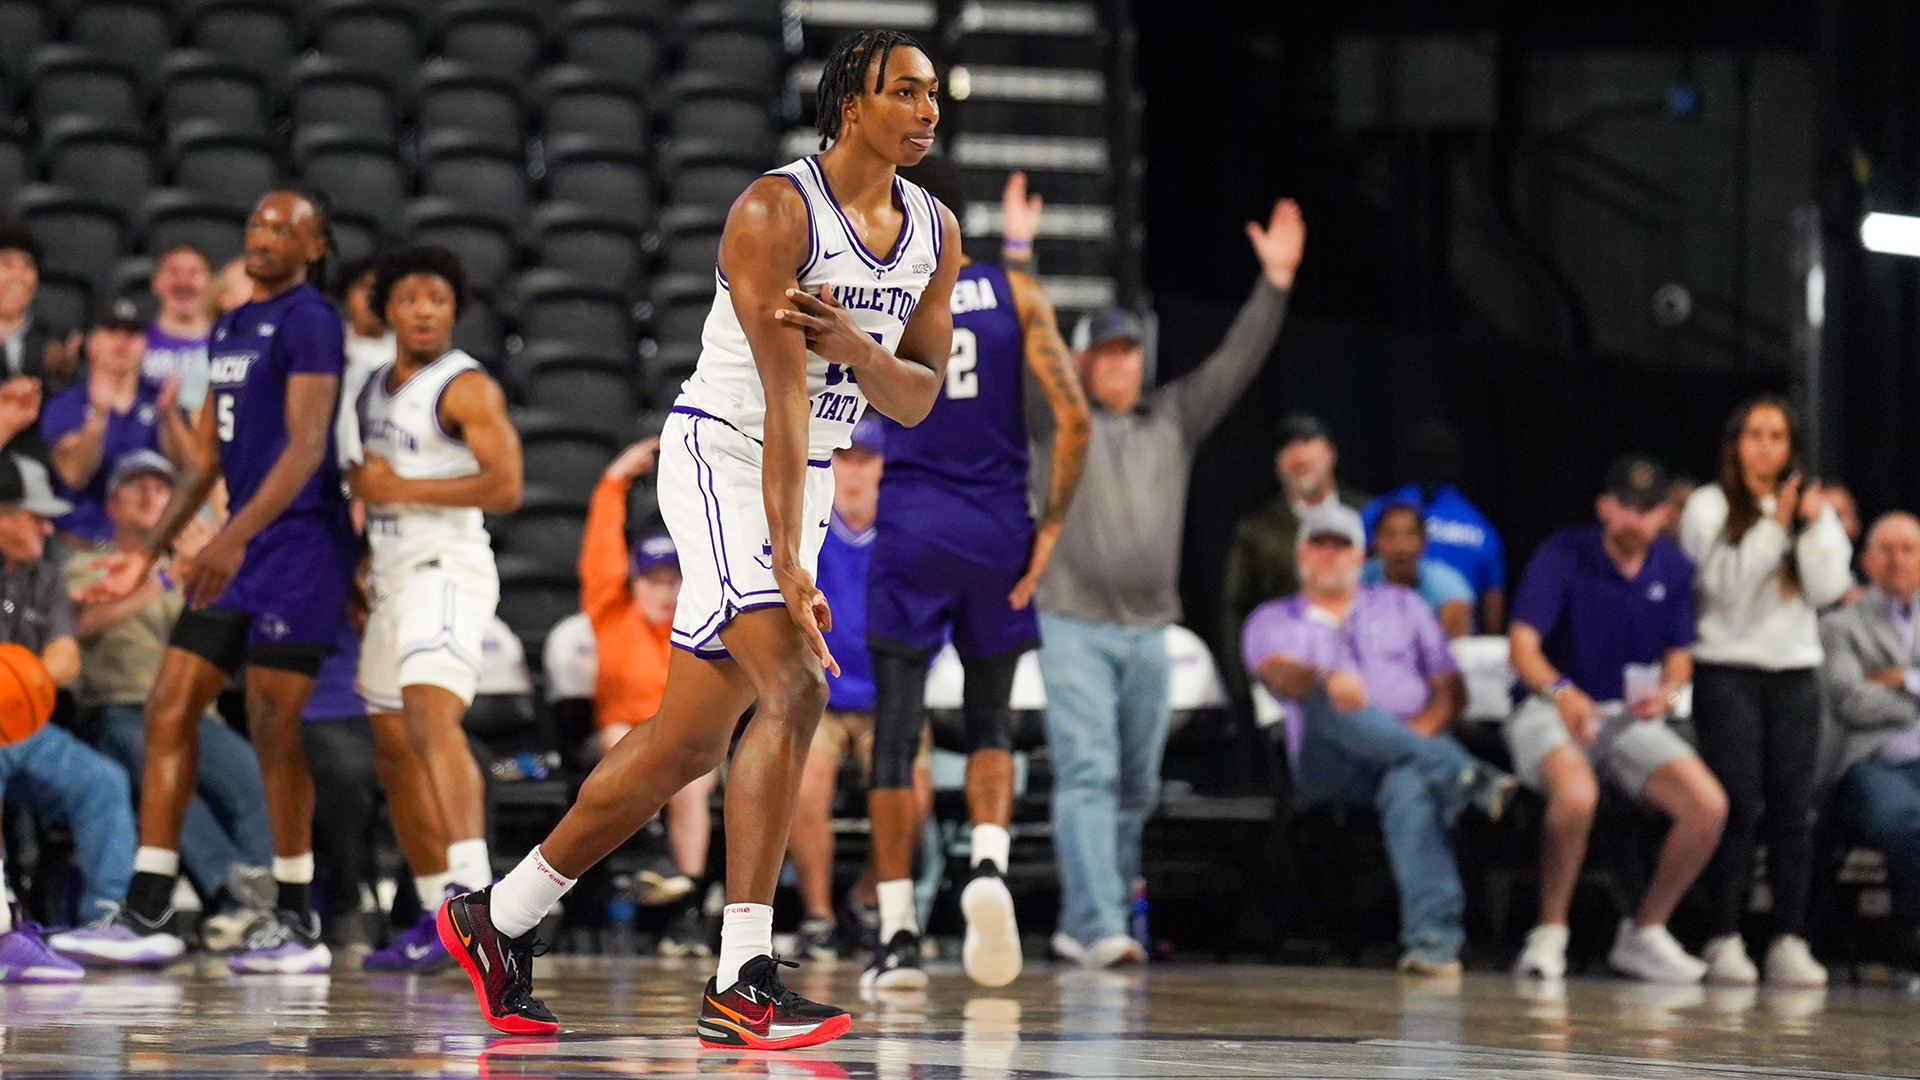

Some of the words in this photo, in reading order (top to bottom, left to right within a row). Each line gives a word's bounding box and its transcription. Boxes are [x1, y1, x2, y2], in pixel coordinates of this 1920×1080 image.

[830, 285, 917, 326] RLETO
[950, 277, 999, 315] ERA
[946, 327, 979, 400] 2
[218, 393, 235, 443] 5
[809, 391, 859, 425] TAT
[532, 851, 566, 887] Supreme
[723, 906, 750, 917] reme
